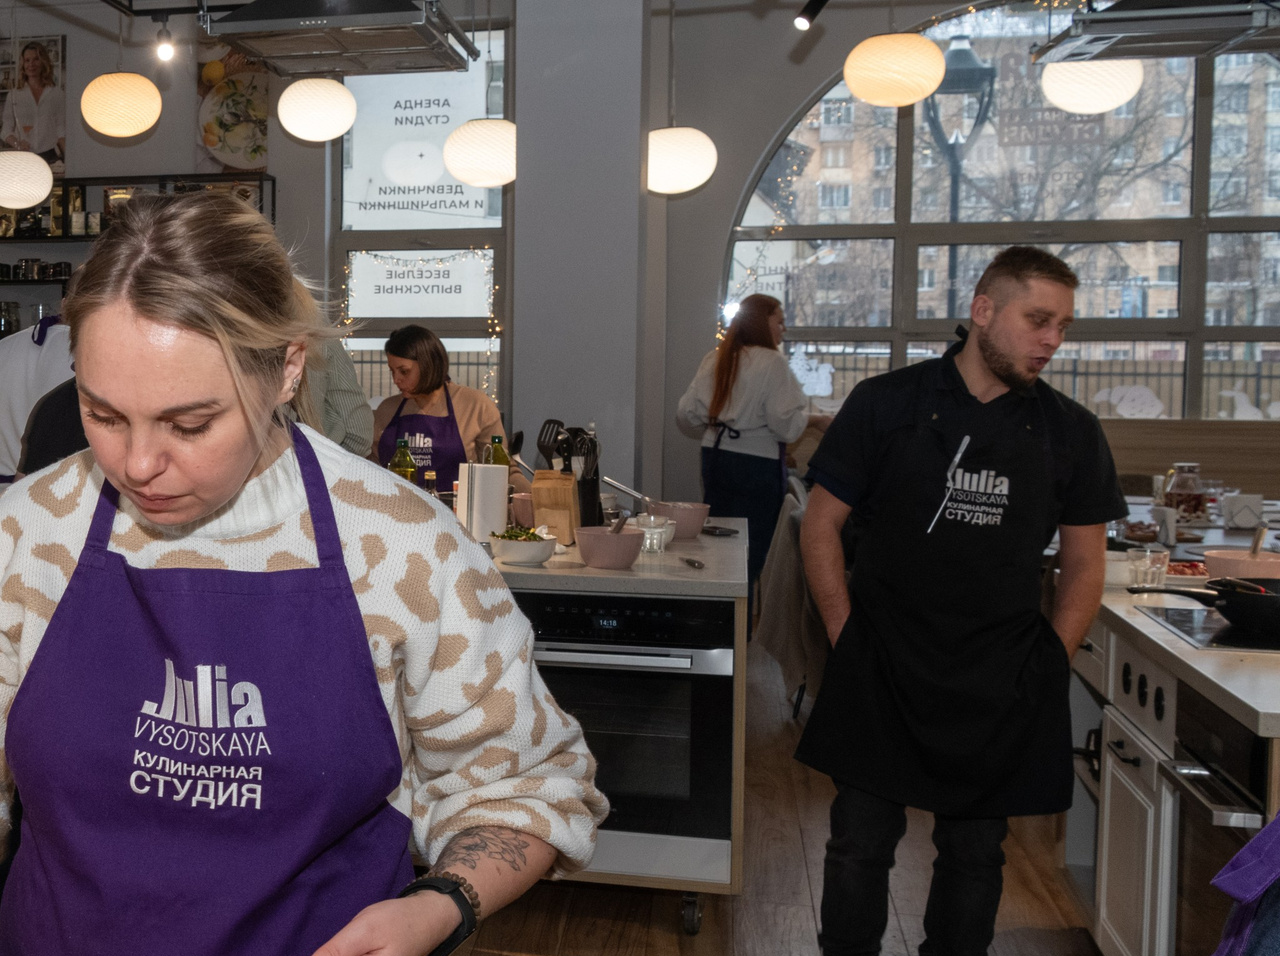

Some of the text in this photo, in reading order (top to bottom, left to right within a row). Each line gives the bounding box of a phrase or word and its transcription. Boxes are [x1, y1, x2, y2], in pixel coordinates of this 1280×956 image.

[415, 459, 432, 467] ДИЯ
[945, 467, 1011, 495] Julia
[944, 509, 1002, 526] СТУДИЯ
[946, 501, 1004, 515] КУЛИНАРНАЯ
[599, 619, 617, 627] 14:18
[140, 658, 268, 729] Julia
[134, 716, 272, 757] VYSOTSKAYA
[133, 749, 263, 781] КУЛИНАРНАЯ
[129, 770, 262, 810] СТУДИЯ
